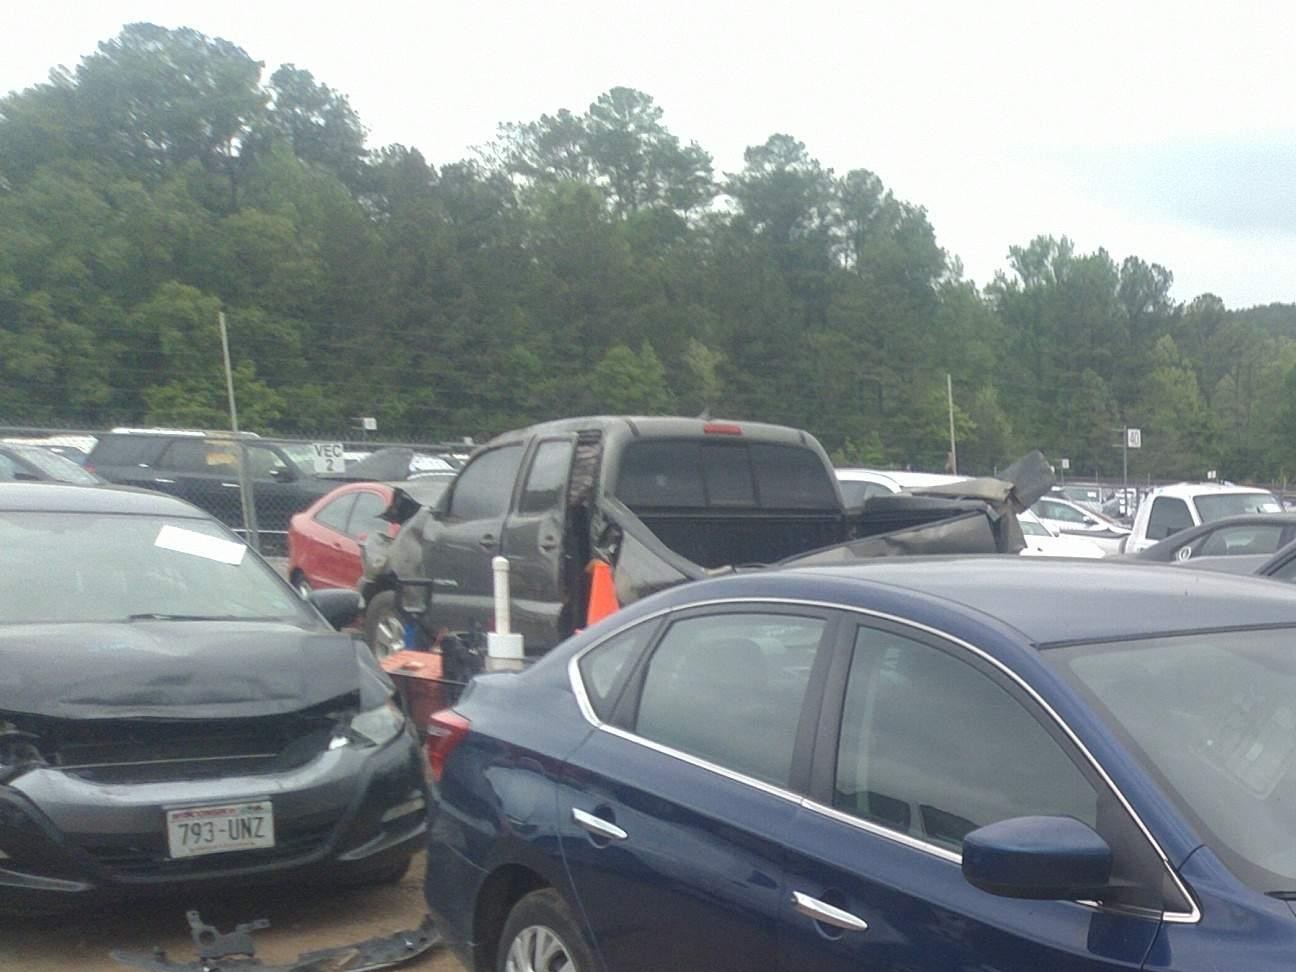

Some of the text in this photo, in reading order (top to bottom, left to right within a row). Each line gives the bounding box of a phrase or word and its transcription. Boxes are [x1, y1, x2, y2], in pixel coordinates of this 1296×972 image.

[313, 444, 342, 458] VEC
[325, 458, 335, 472] 2
[177, 816, 265, 846] 793-UNZ
